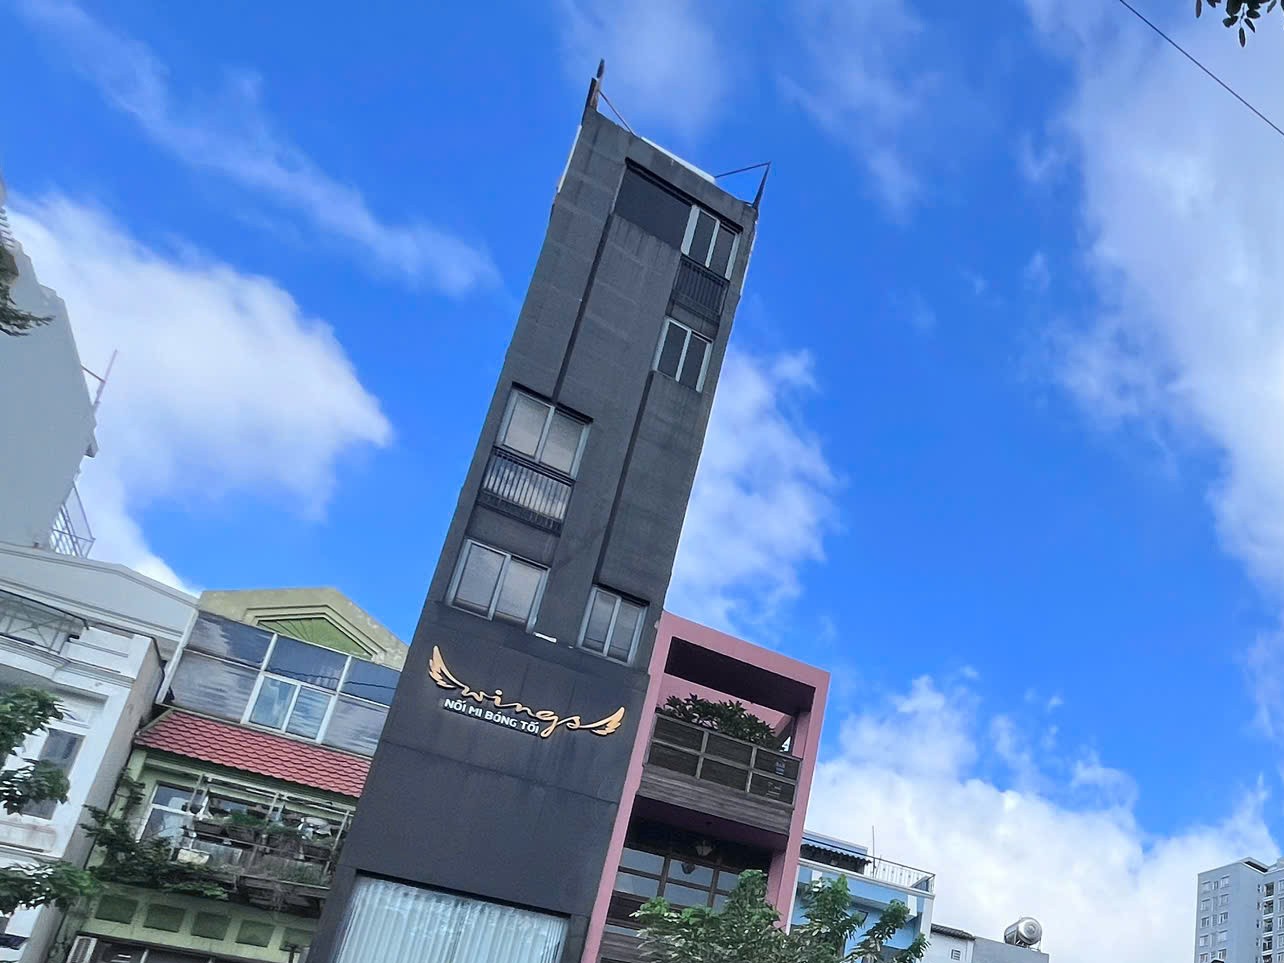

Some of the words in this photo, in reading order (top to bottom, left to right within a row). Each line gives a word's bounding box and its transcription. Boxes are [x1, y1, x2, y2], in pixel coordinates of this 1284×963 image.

[444, 698, 466, 713] NỐI
[468, 706, 482, 718] MI
[485, 709, 517, 728] BÓNG
[520, 721, 540, 734] TỐI
